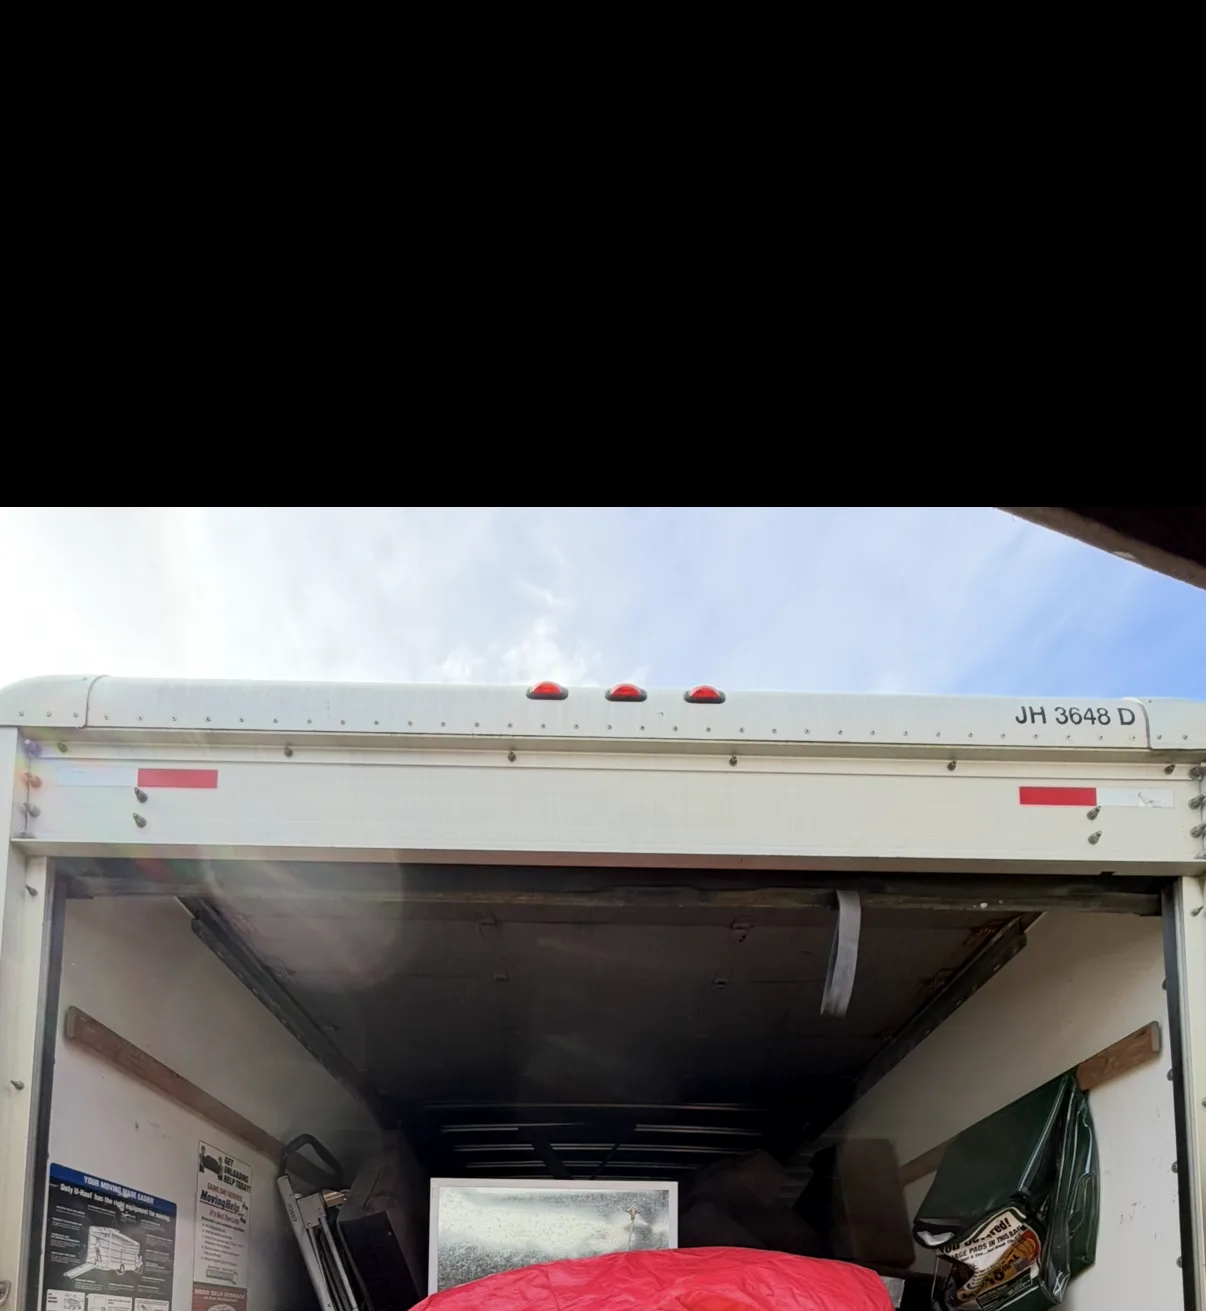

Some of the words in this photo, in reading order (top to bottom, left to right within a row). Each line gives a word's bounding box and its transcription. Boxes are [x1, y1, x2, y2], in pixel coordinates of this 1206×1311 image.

[1015, 706, 1047, 724] JH
[1055, 706, 1111, 725] 3648
[1117, 707, 1136, 726] D
[60, 1183, 73, 1195] Only
[84, 1175, 99, 1187] YOUR
[100, 1181, 121, 1193] MOVING
[137, 1192, 154, 1204] EASIER
[951, 1249, 967, 1260] ARGE
[969, 1243, 987, 1254] PADS
[988, 1240, 996, 1250] IN
[997, 1233, 1010, 1244] THIS
